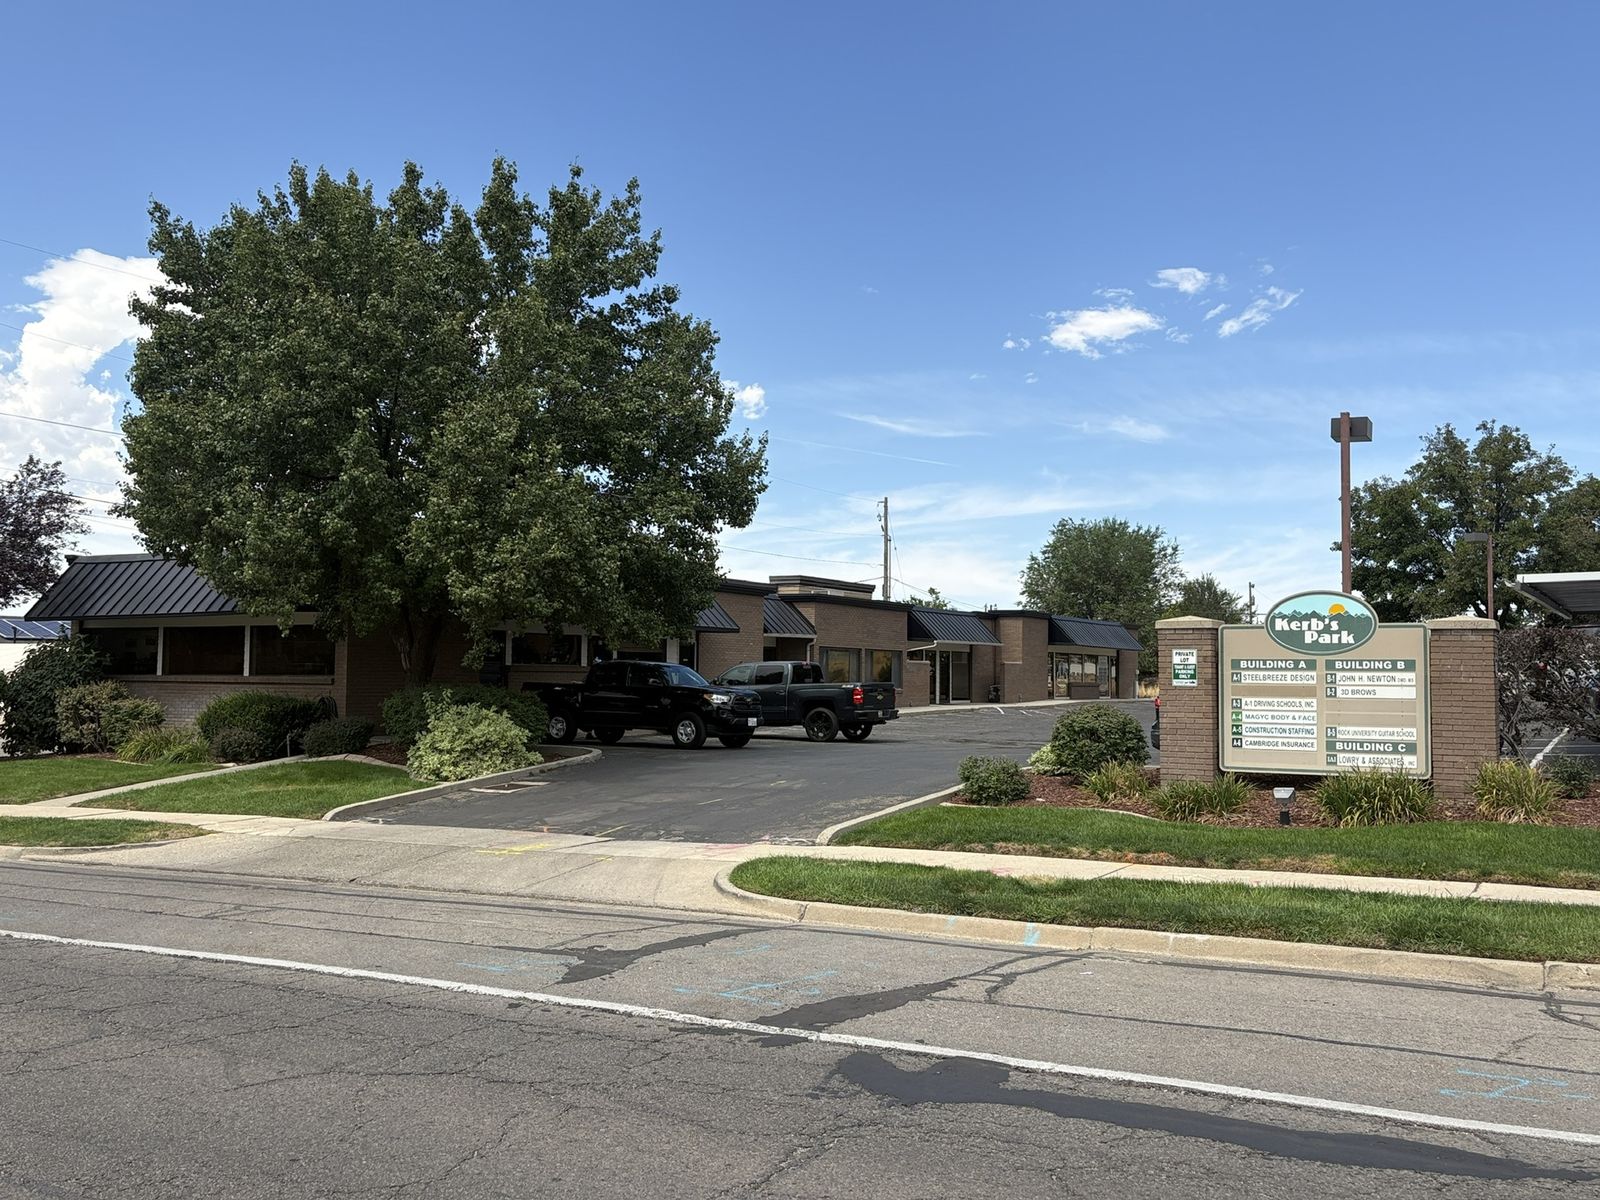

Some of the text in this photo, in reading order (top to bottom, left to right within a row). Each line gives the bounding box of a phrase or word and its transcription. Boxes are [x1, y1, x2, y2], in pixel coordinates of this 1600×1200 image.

[1274, 618, 1339, 631] Kerb's
[1304, 631, 1355, 644] Park
[1335, 661, 1405, 669] BUILDING B
[1335, 742, 1393, 751] BUILDING
